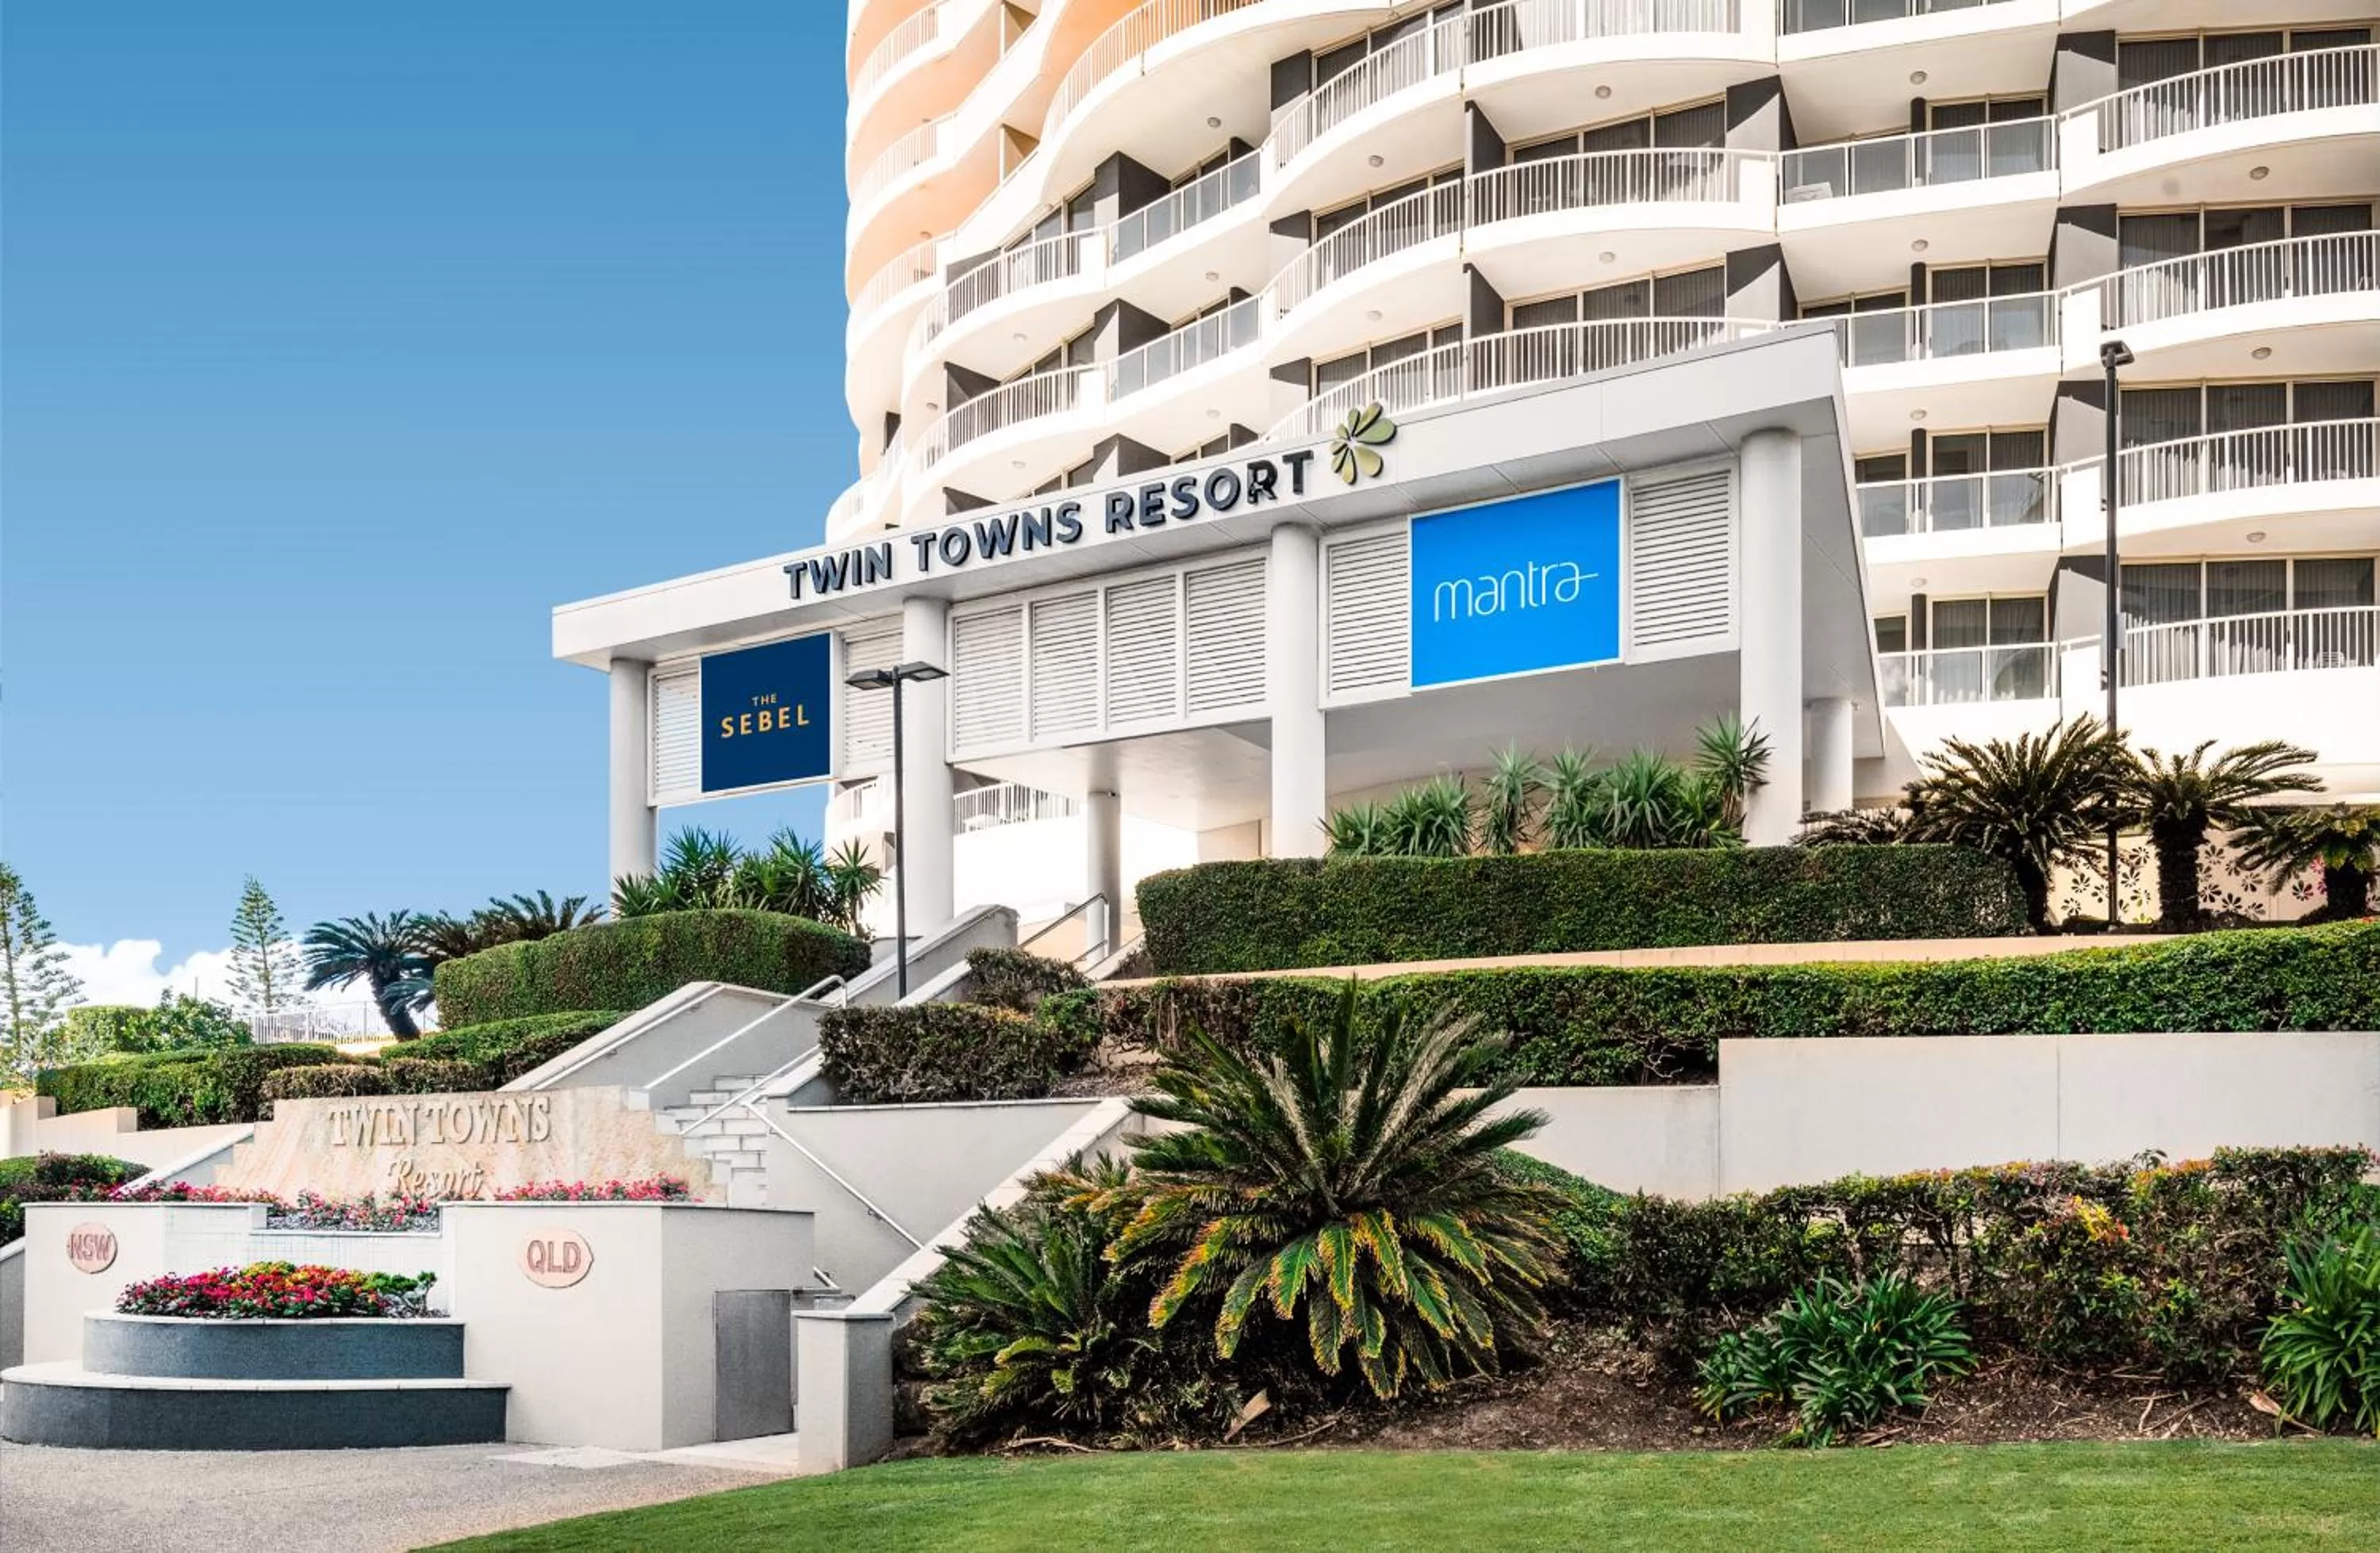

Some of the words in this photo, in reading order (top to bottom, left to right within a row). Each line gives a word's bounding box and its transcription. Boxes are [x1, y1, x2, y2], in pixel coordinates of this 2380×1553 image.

[783, 541, 892, 599] TWIN
[911, 501, 1082, 573] TOWNS
[1106, 450, 1314, 535] RESORT
[1434, 561, 1599, 623] mantra
[752, 692, 777, 707] THE
[720, 704, 810, 738] SEBEL
[329, 1103, 420, 1147] TWIN
[426, 1096, 551, 1145] TOWNS
[387, 1157, 486, 1198] Resort
[71, 1233, 111, 1260] NSW
[527, 1240, 582, 1274] QLD
